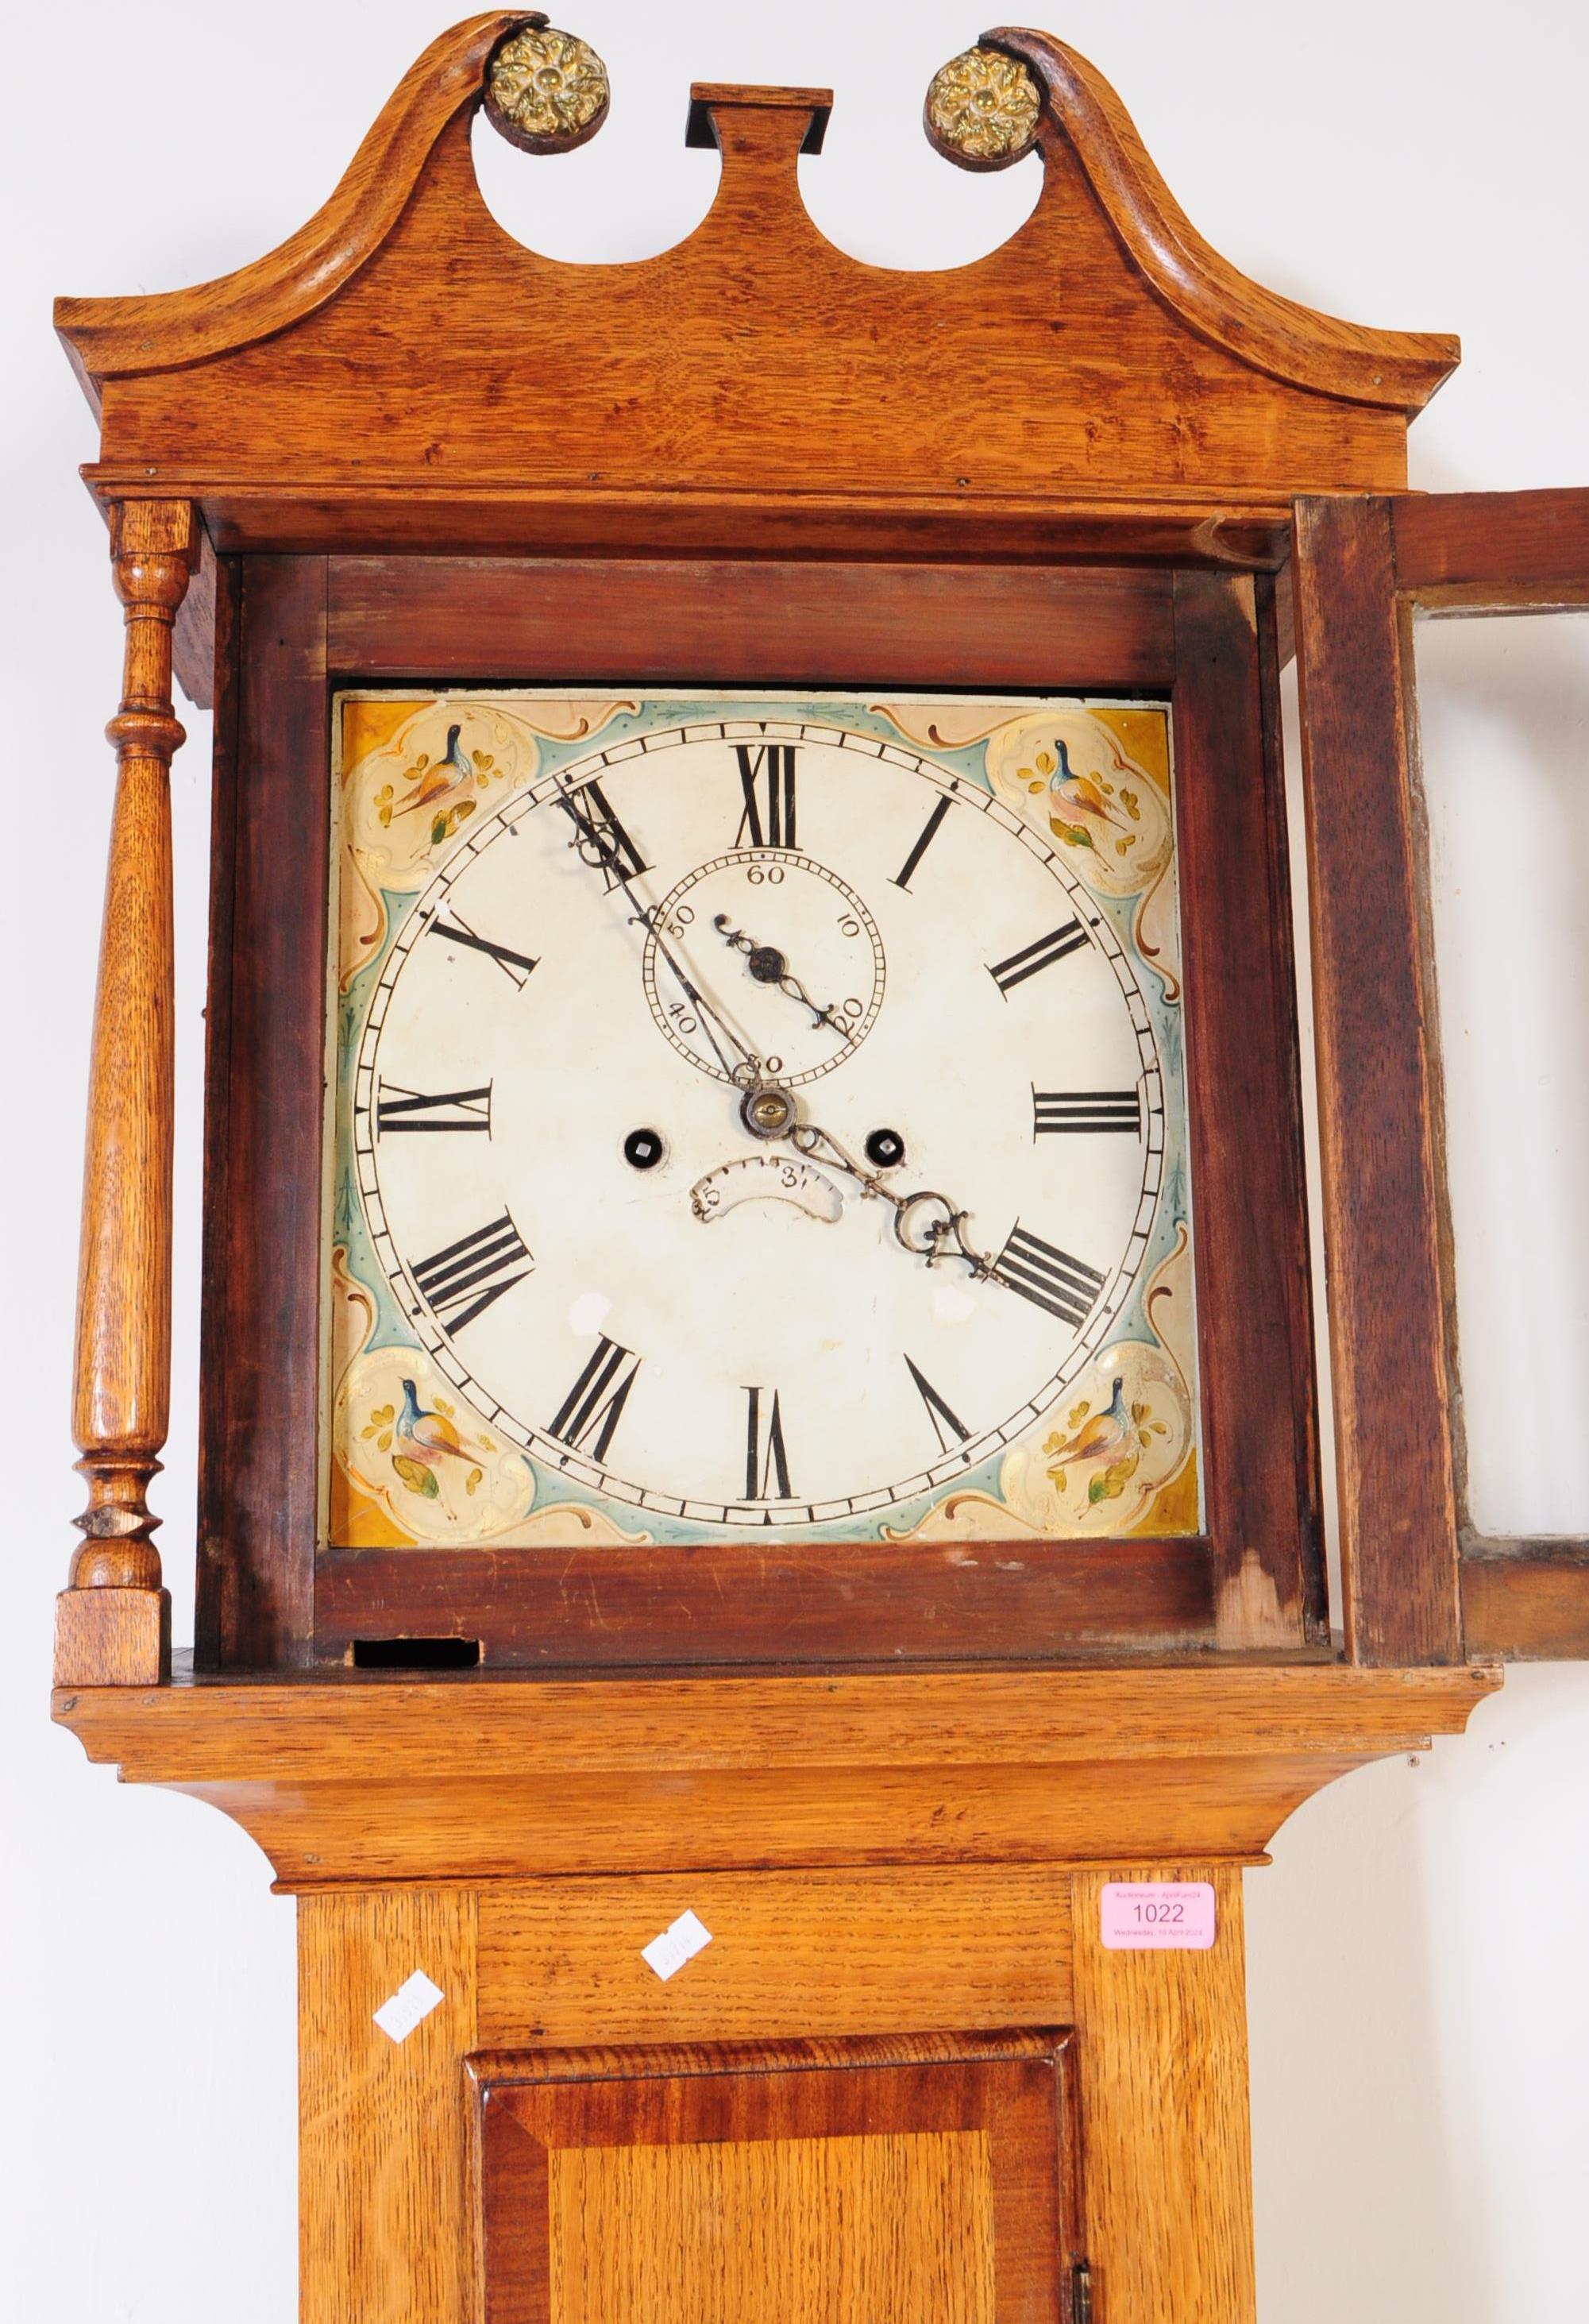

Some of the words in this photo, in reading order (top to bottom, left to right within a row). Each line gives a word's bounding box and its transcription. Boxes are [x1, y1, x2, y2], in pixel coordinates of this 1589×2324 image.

[727, 743, 803, 850] XII
[746, 864, 786, 885] 60
[422, 896, 541, 991] X
[667, 905, 696, 940] 50
[836, 912, 861, 939] 10
[984, 911, 1098, 1001] II
[669, 1002, 698, 1035] 40
[831, 998, 864, 1038] 20
[378, 1078, 492, 1141] IX
[1033, 1082, 1144, 1145] III
[409, 1205, 535, 1340] VIII
[540, 1333, 642, 1466] VII
[904, 1353, 981, 1458] V
[739, 1386, 799, 1500] VI
[1134, 1904, 1184, 1923] 1022
